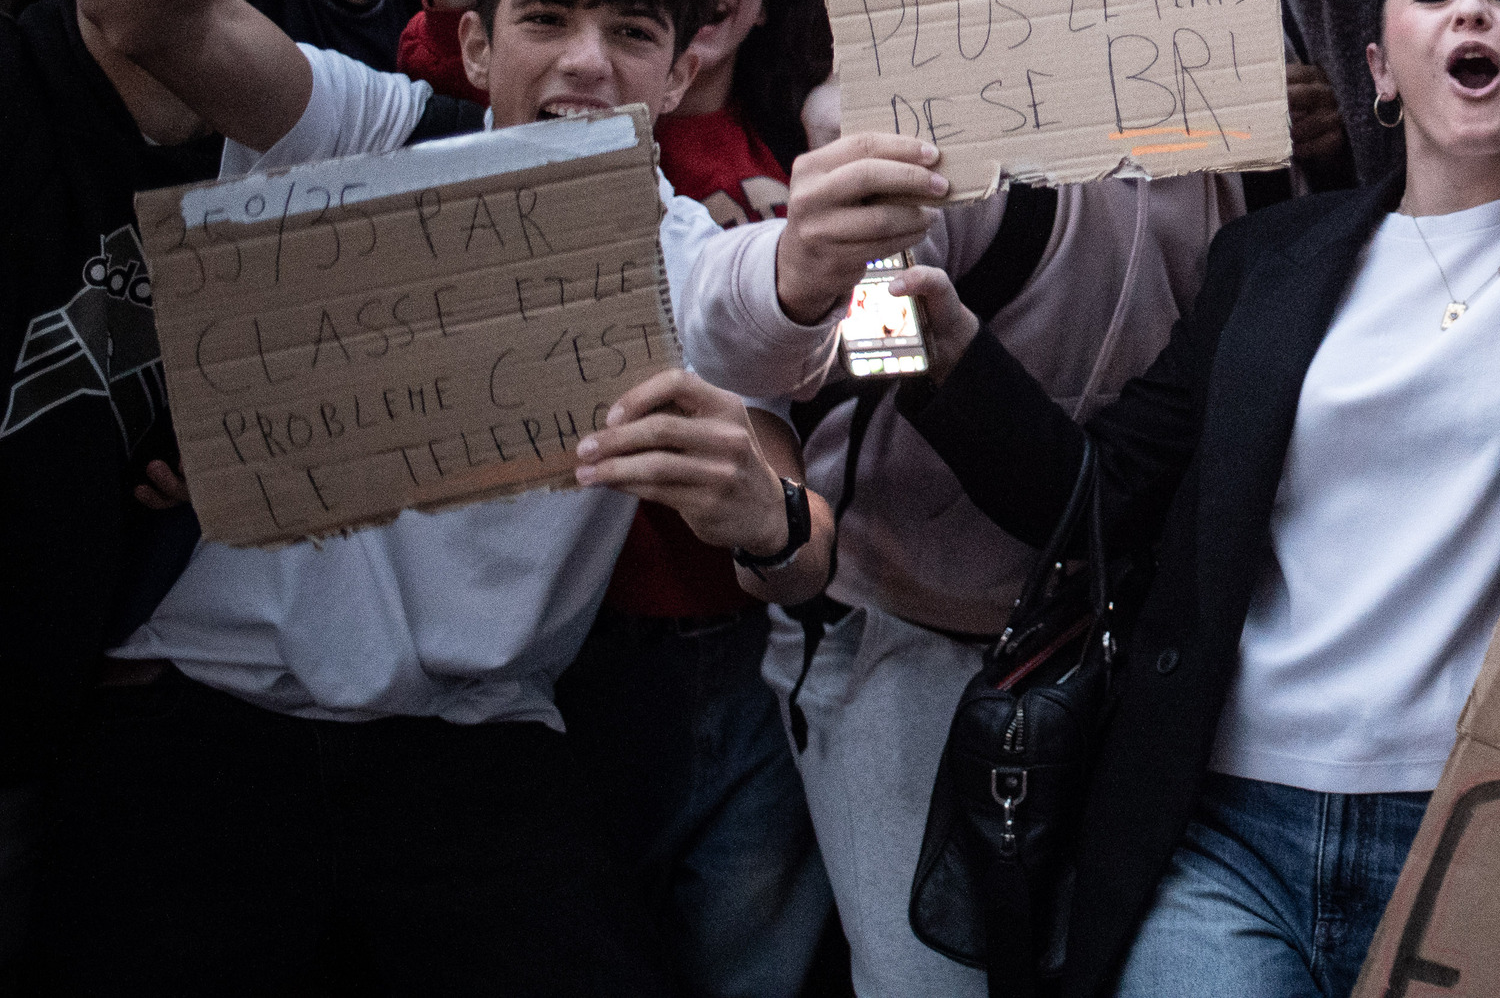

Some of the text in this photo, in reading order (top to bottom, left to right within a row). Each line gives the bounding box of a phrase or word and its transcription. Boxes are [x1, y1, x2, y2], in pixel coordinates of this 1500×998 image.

[890, 93, 965, 145] DE
[980, 68, 1063, 135] SE
[417, 187, 555, 259] PAR
[196, 285, 466, 396] CLASSE
[516, 275, 571, 322] ET
[490, 320, 667, 412] C'EST
[255, 467, 331, 529] LE
